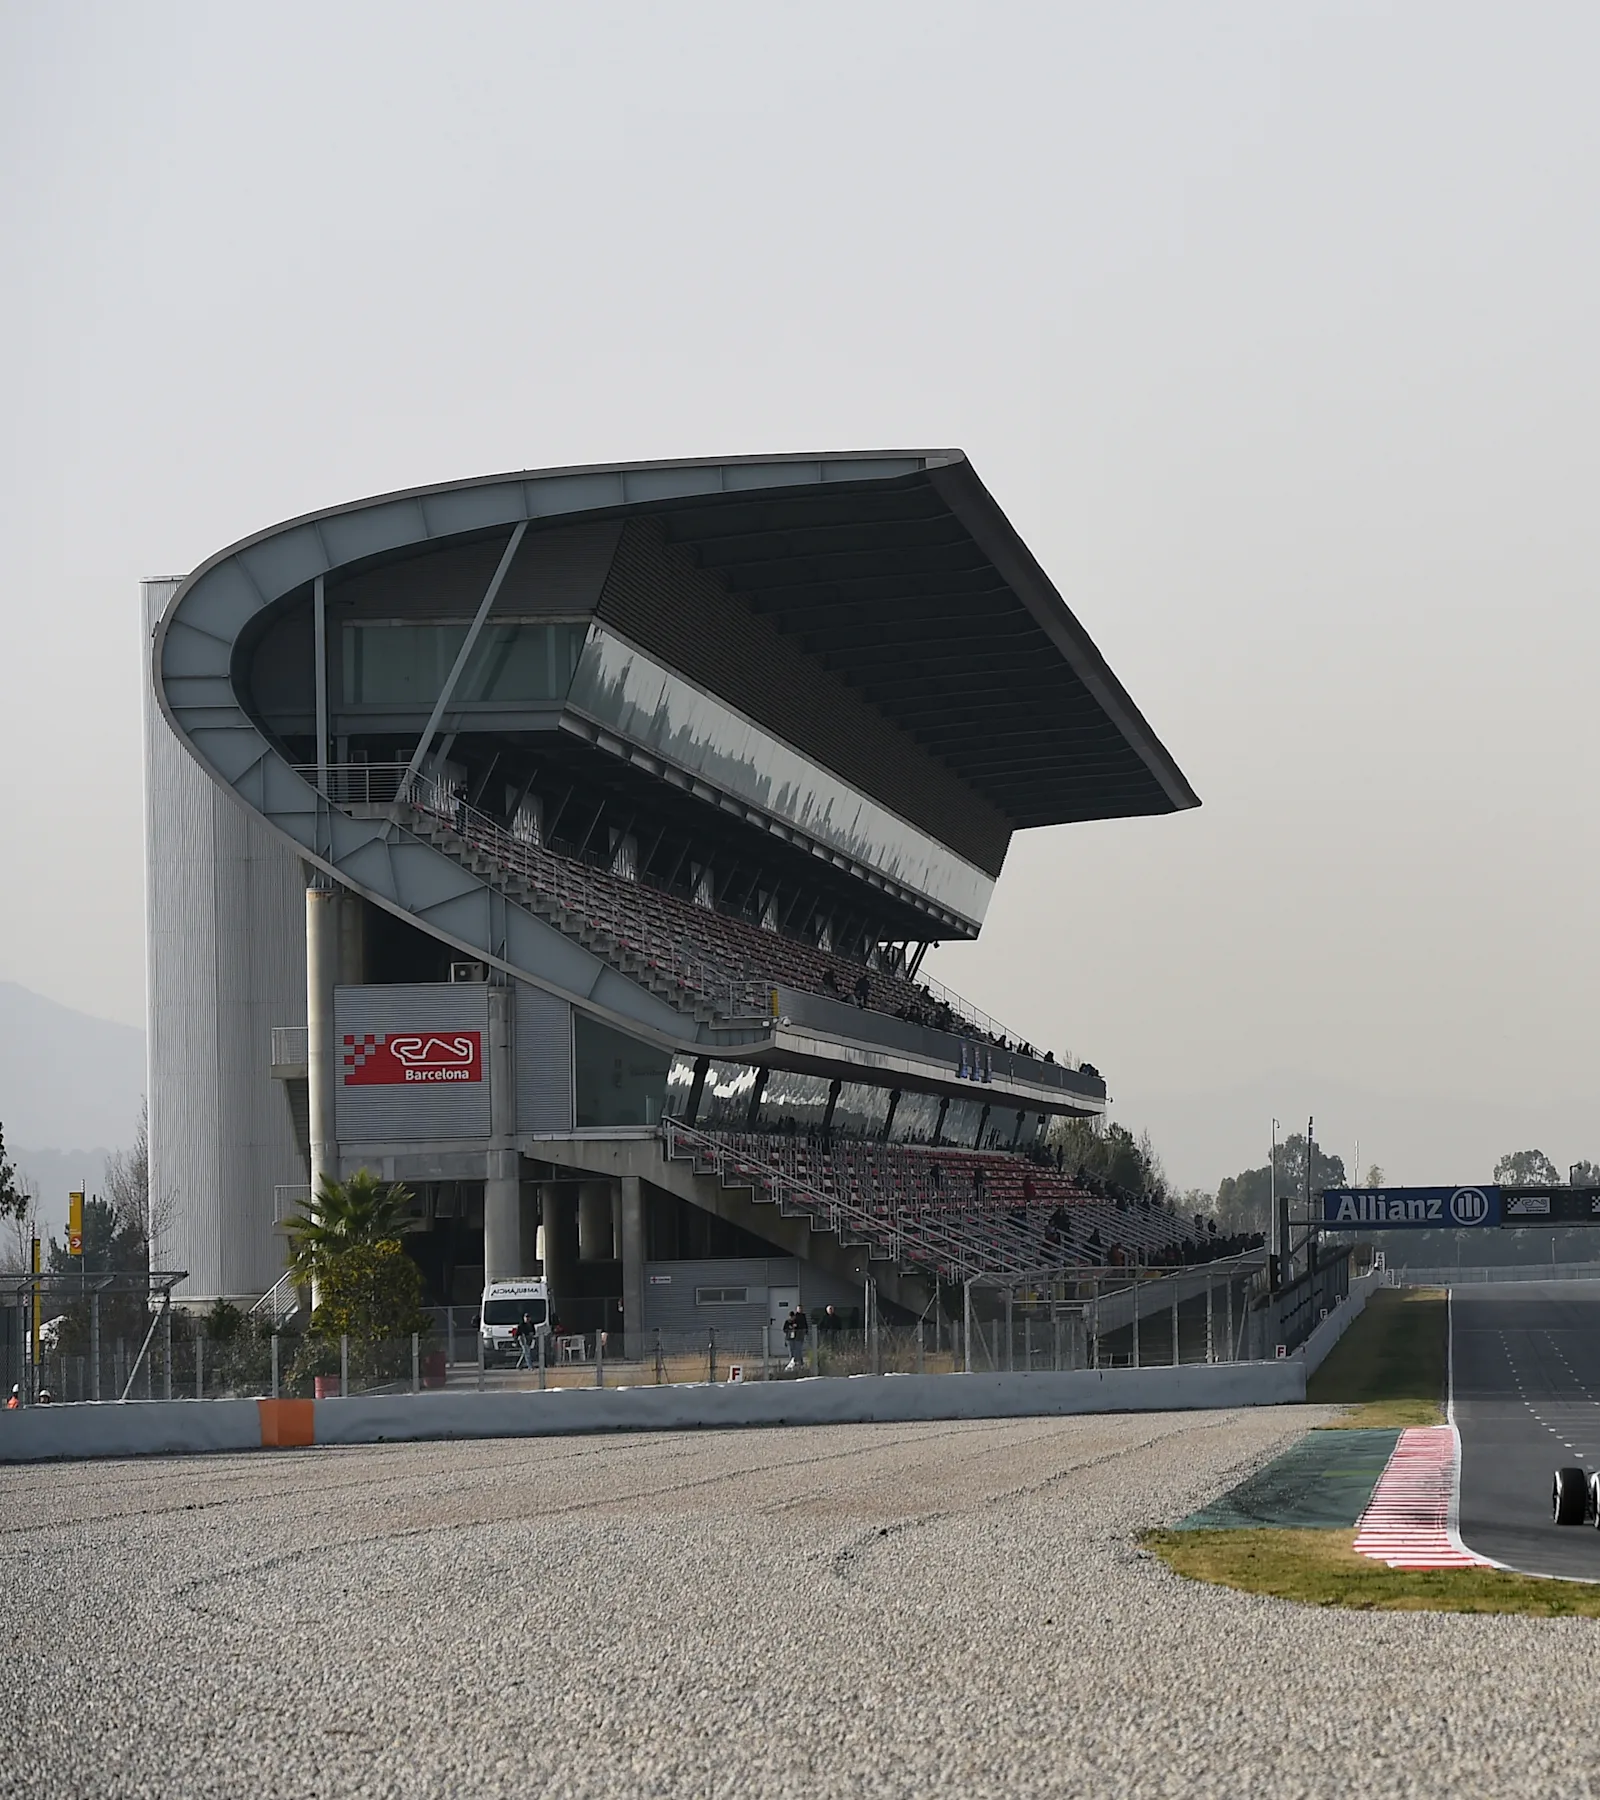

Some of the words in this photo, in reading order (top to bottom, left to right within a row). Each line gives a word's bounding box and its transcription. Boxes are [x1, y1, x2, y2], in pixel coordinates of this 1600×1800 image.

[404, 1067, 470, 1082] Barcelona
[1335, 1194, 1443, 1221] Allianz
[1277, 1346, 1285, 1358] F
[731, 1367, 741, 1381] F
